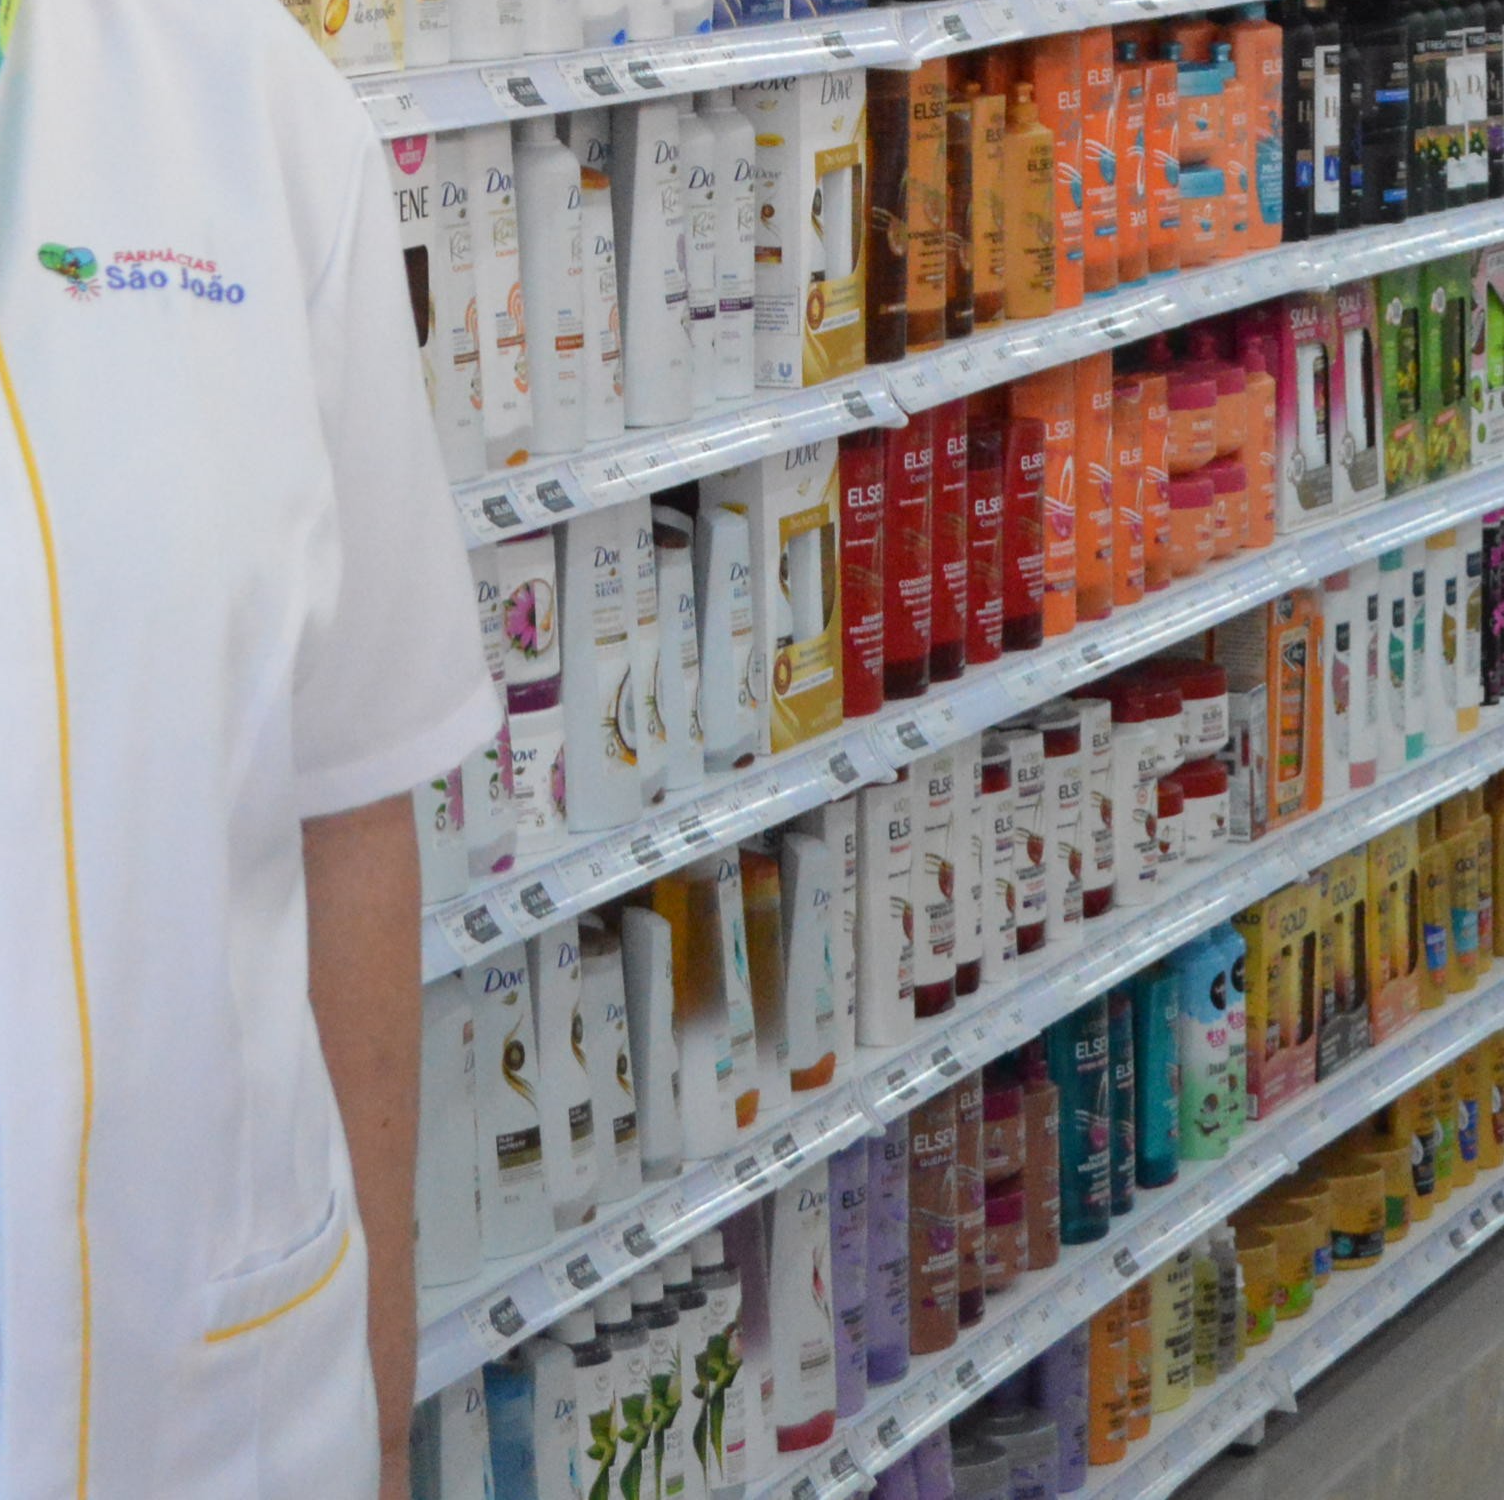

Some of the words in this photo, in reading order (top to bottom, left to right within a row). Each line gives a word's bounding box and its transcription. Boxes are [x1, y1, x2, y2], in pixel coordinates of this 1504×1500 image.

[821, 72, 852, 105] Dove
[690, 167, 715, 189] Do
[734, 159, 755, 181] Do
[114, 248, 216, 273] FARMÁCIAS
[106, 264, 167, 289] São
[181, 267, 244, 303] João
[1291, 307, 1317, 328] SKALA
[905, 450, 932, 470] ELSE
[848, 484, 883, 507] ELSE
